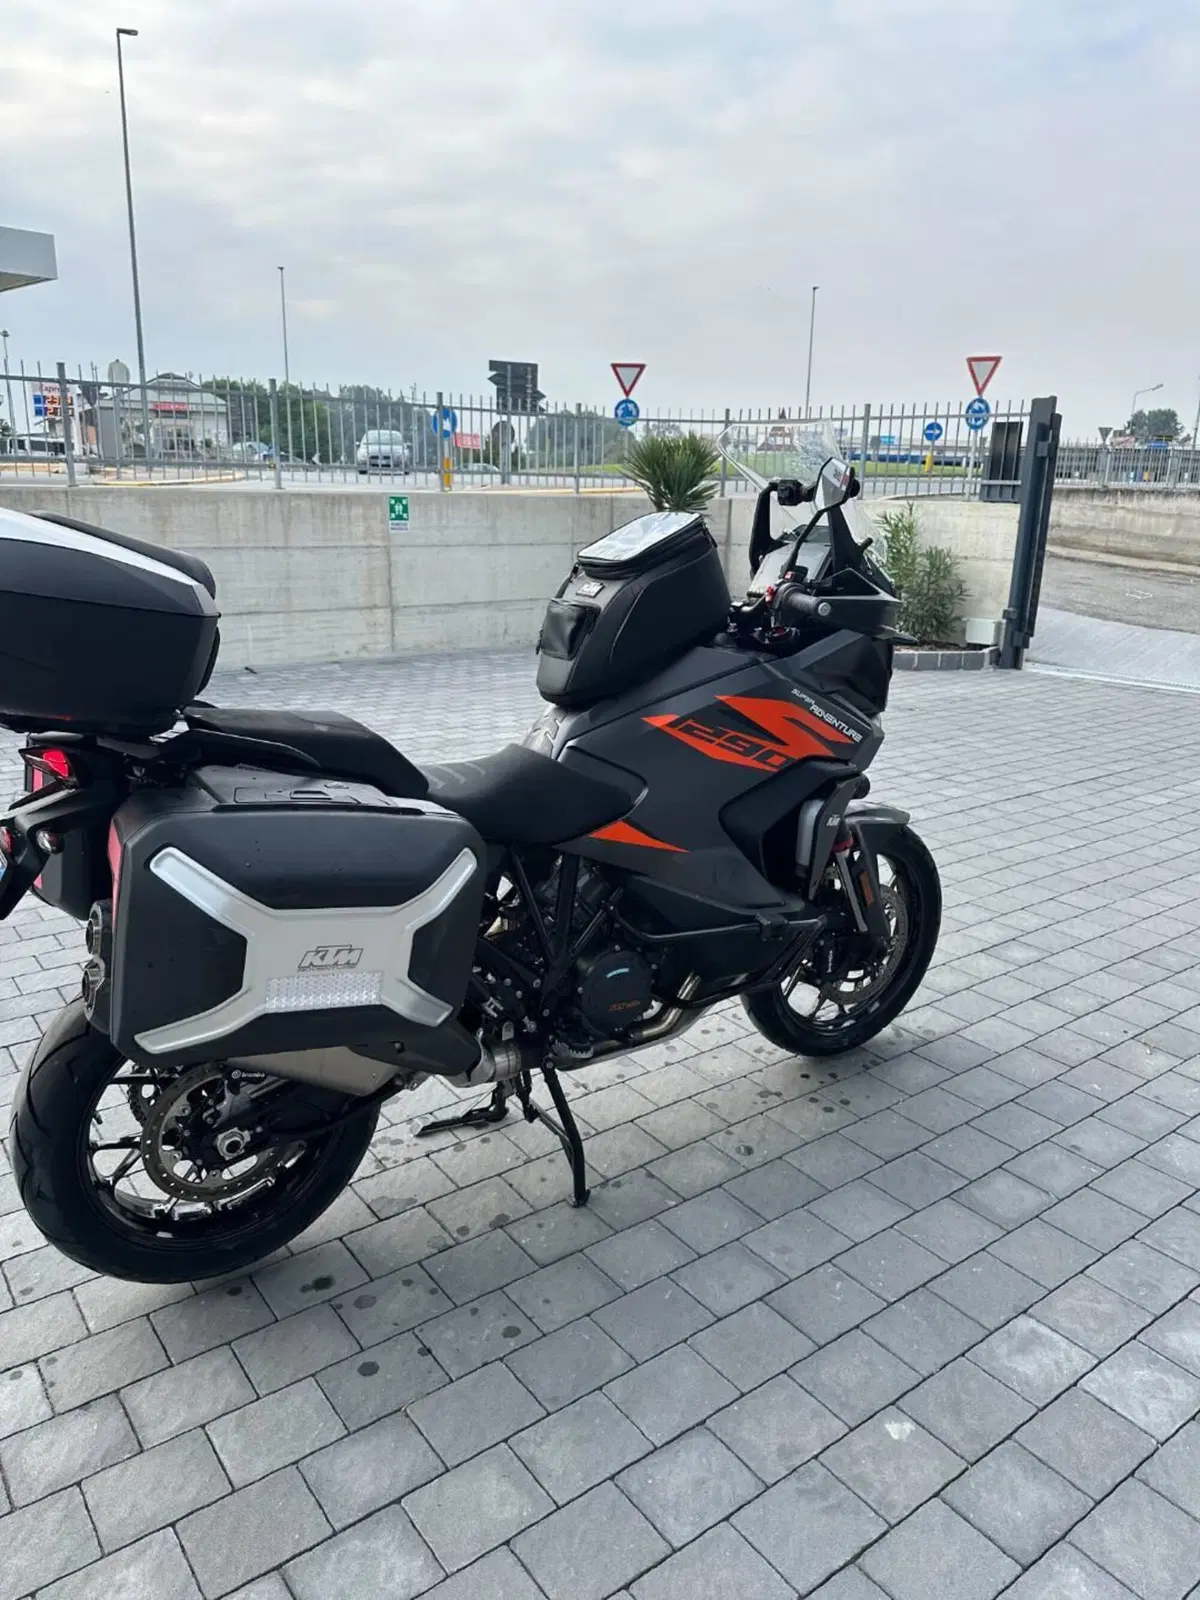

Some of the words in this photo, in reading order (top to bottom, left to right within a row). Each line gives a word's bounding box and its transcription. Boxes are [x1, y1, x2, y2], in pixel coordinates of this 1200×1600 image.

[40, 383, 70, 392] Expres
[809, 704, 863, 743] ADVENTURE
[298, 944, 364, 968] KTM
